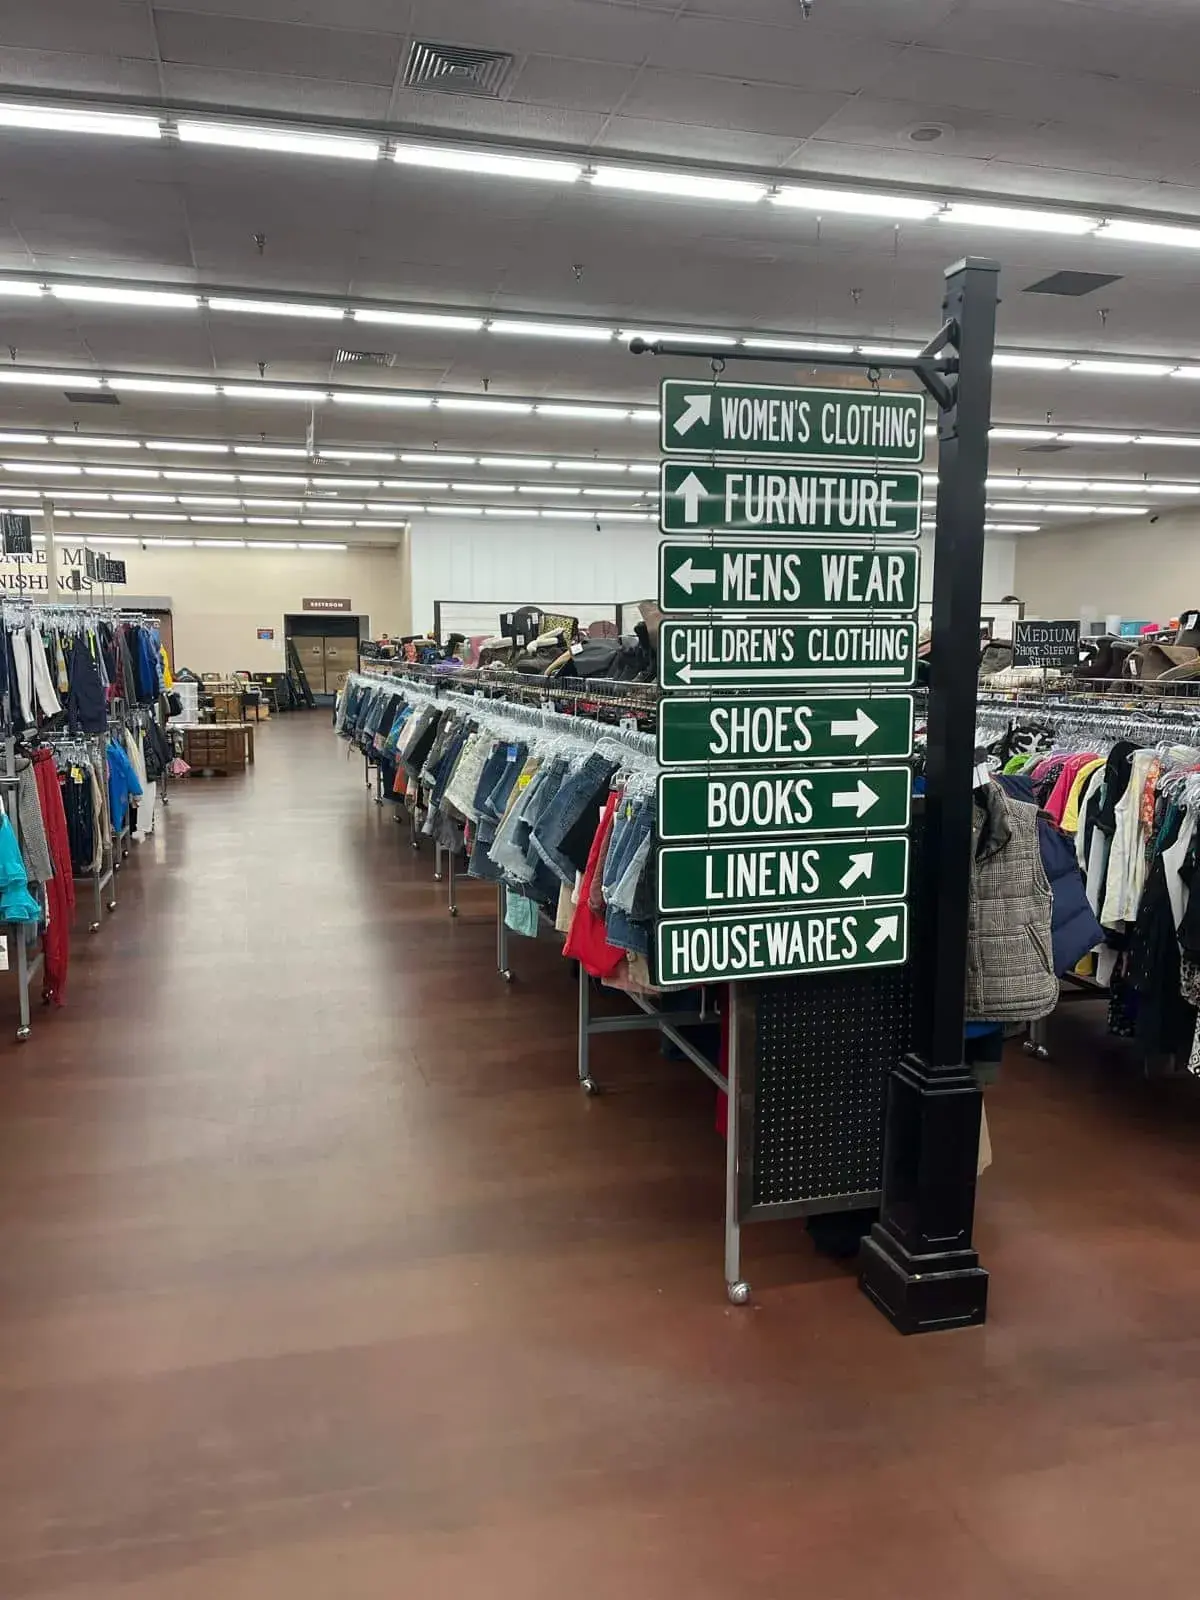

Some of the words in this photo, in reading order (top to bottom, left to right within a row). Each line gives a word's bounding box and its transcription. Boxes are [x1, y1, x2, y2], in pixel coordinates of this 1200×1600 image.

[721, 397, 810, 442] WOMEN'S
[822, 403, 916, 447] CLOTHING
[726, 473, 898, 527] FURNITURE
[723, 553, 800, 601] MENS
[822, 555, 904, 601] WEAR
[671, 628, 794, 662] CHILDREN'S
[808, 629, 908, 661] CLOTHING
[710, 706, 812, 753] SHOES
[708, 779, 813, 827] BOOKS
[706, 850, 820, 900] LINENS
[671, 916, 858, 975] HOUSEWARES
